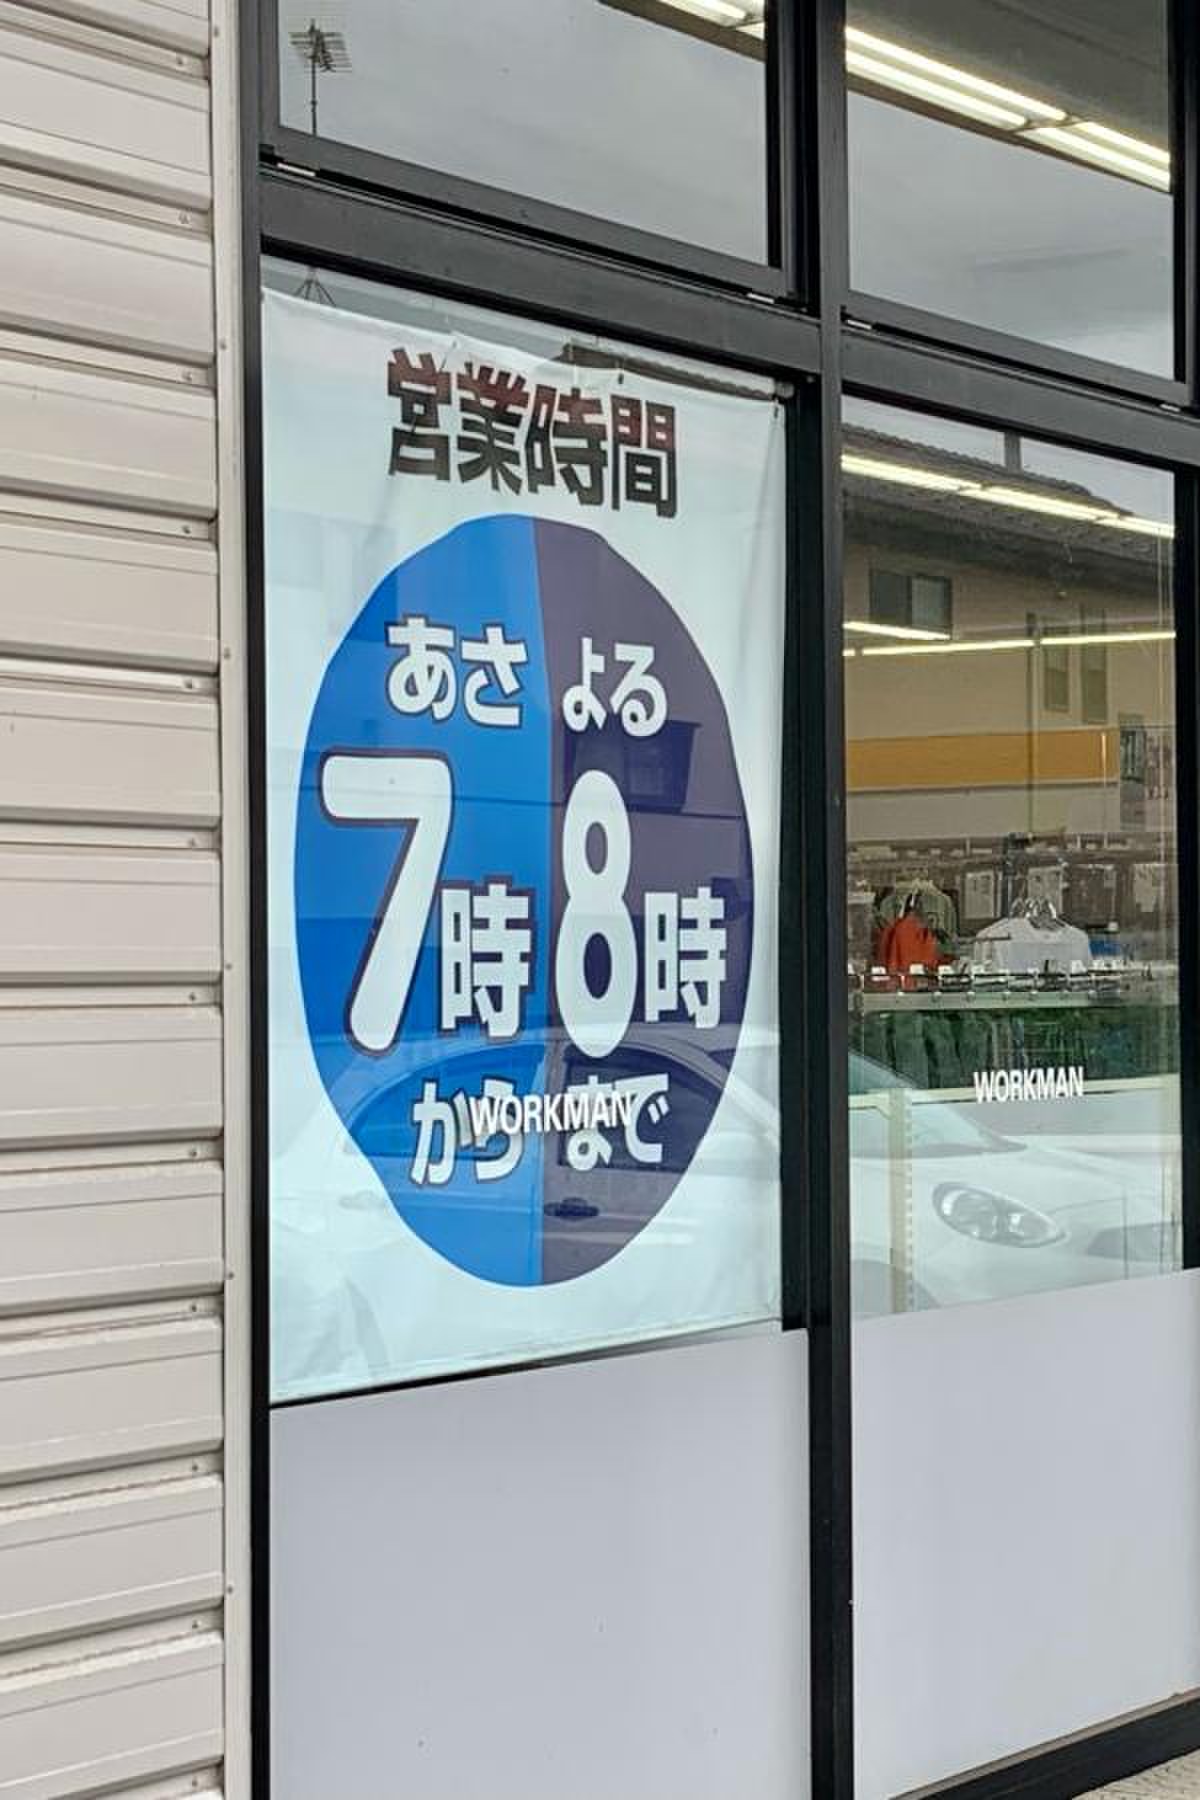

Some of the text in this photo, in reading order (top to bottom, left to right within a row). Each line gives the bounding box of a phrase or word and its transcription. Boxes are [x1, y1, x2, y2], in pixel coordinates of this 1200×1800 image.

[387, 347, 678, 519] 営業時間
[385, 615, 668, 738] あさ よる
[411, 1073, 670, 1184] から まで
[470, 1091, 634, 1137] WORKMAN
[973, 1066, 1085, 1103] WORKMAN
